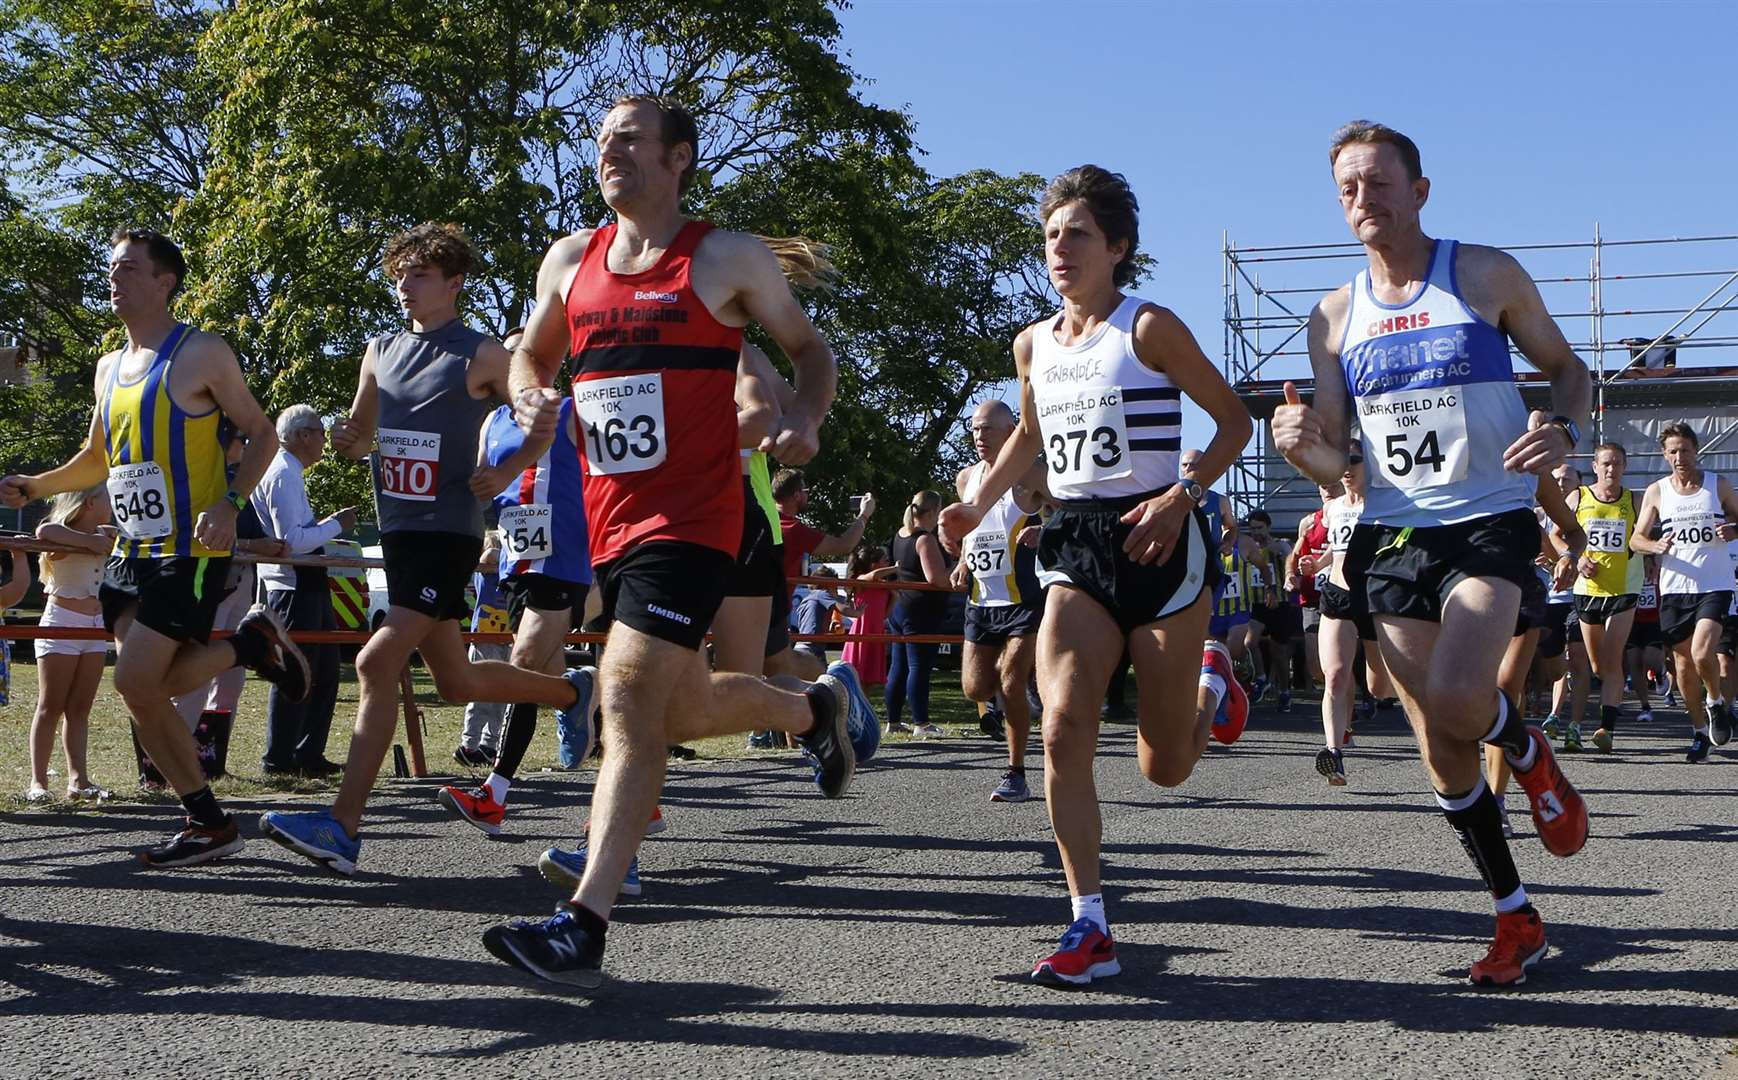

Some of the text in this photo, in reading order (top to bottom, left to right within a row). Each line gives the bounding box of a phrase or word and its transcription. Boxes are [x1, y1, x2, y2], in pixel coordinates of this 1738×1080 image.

[634, 291, 677, 303] Bellway
[1367, 312, 1431, 337] CHRIS
[1447, 362, 1471, 377] AC
[578, 382, 657, 403] LARKFIELD AC
[601, 401, 623, 413] 10K
[1040, 395, 1118, 418] LARKFIELD AC
[1362, 395, 1457, 416] LARKFIELD AC
[1066, 414, 1086, 425] 10K
[1395, 415, 1421, 428] 10K
[421, 439, 436, 448] AC
[587, 414, 659, 463] 163
[396, 447, 407, 455] 5K
[1049, 426, 1122, 474] 373
[1386, 430, 1446, 477] 54
[146, 466, 160, 475] AC
[383, 459, 433, 494] 610
[124, 480, 138, 489] 10K
[114, 489, 165, 523] 548
[514, 518, 527, 526] 10K
[503, 527, 548, 553] 154
[1588, 531, 1623, 547] 515
[1677, 526, 1713, 544] 406
[967, 549, 1005, 573] 337
[647, 603, 692, 625] UMBRO
